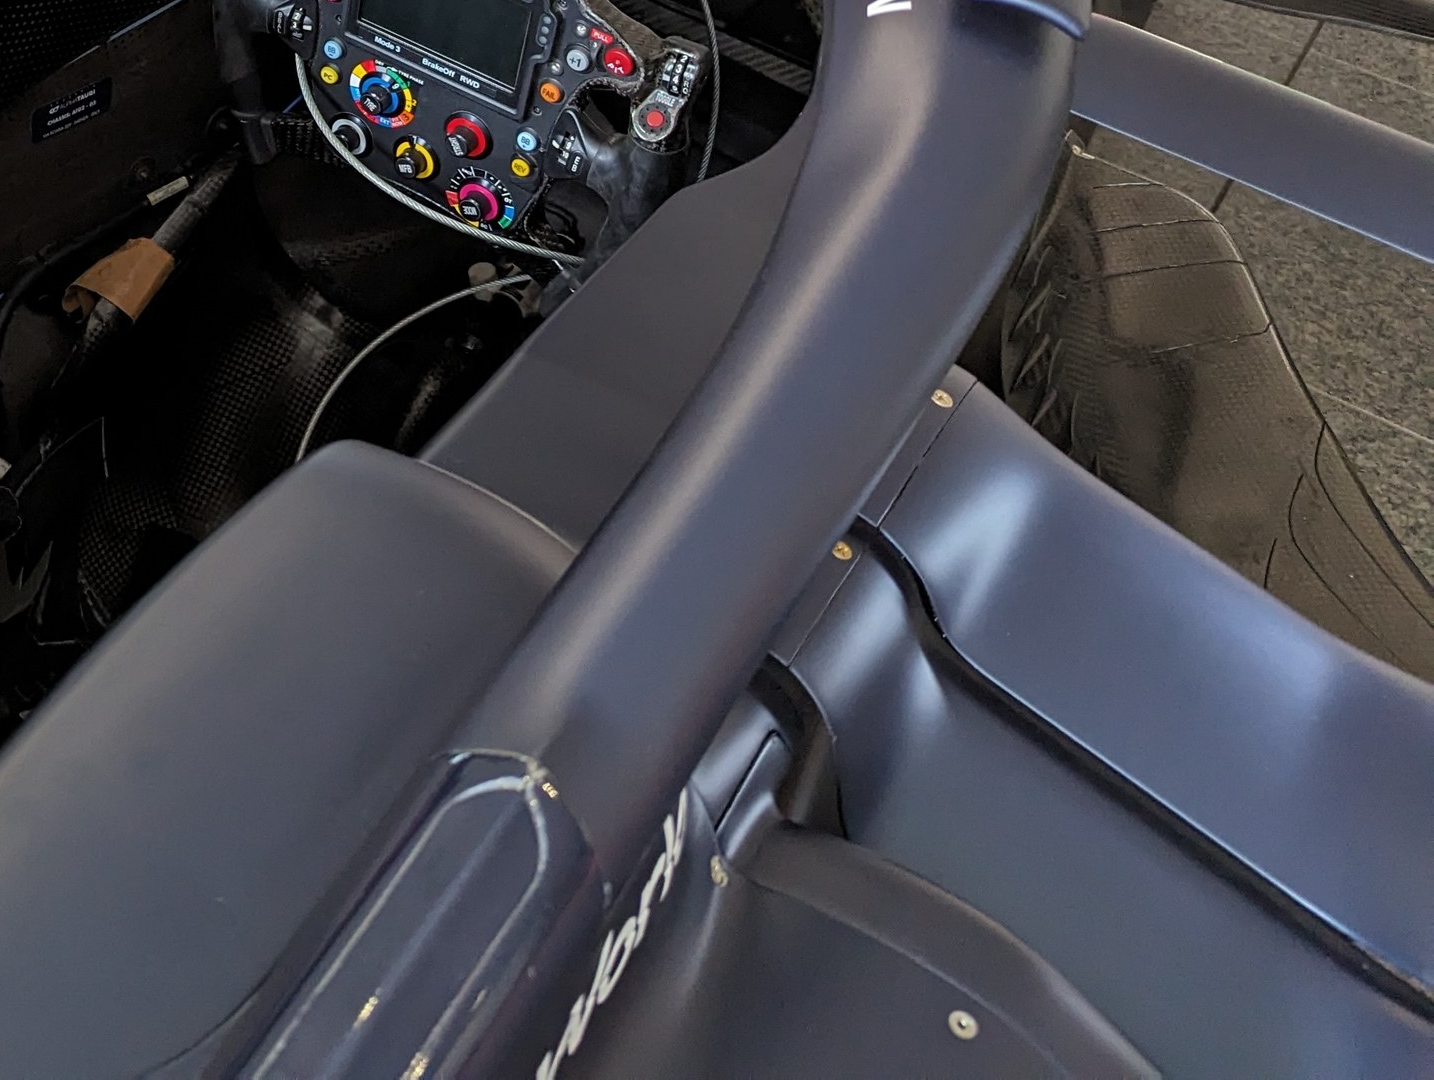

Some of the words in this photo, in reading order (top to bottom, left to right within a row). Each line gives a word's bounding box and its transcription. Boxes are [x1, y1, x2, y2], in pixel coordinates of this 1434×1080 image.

[374, 36, 395, 51] Mode
[422, 58, 456, 78] BrakeOff
[459, 75, 480, 89] RWD
[675, 64, 683, 74] 3
[542, 88, 556, 100] FAIL
